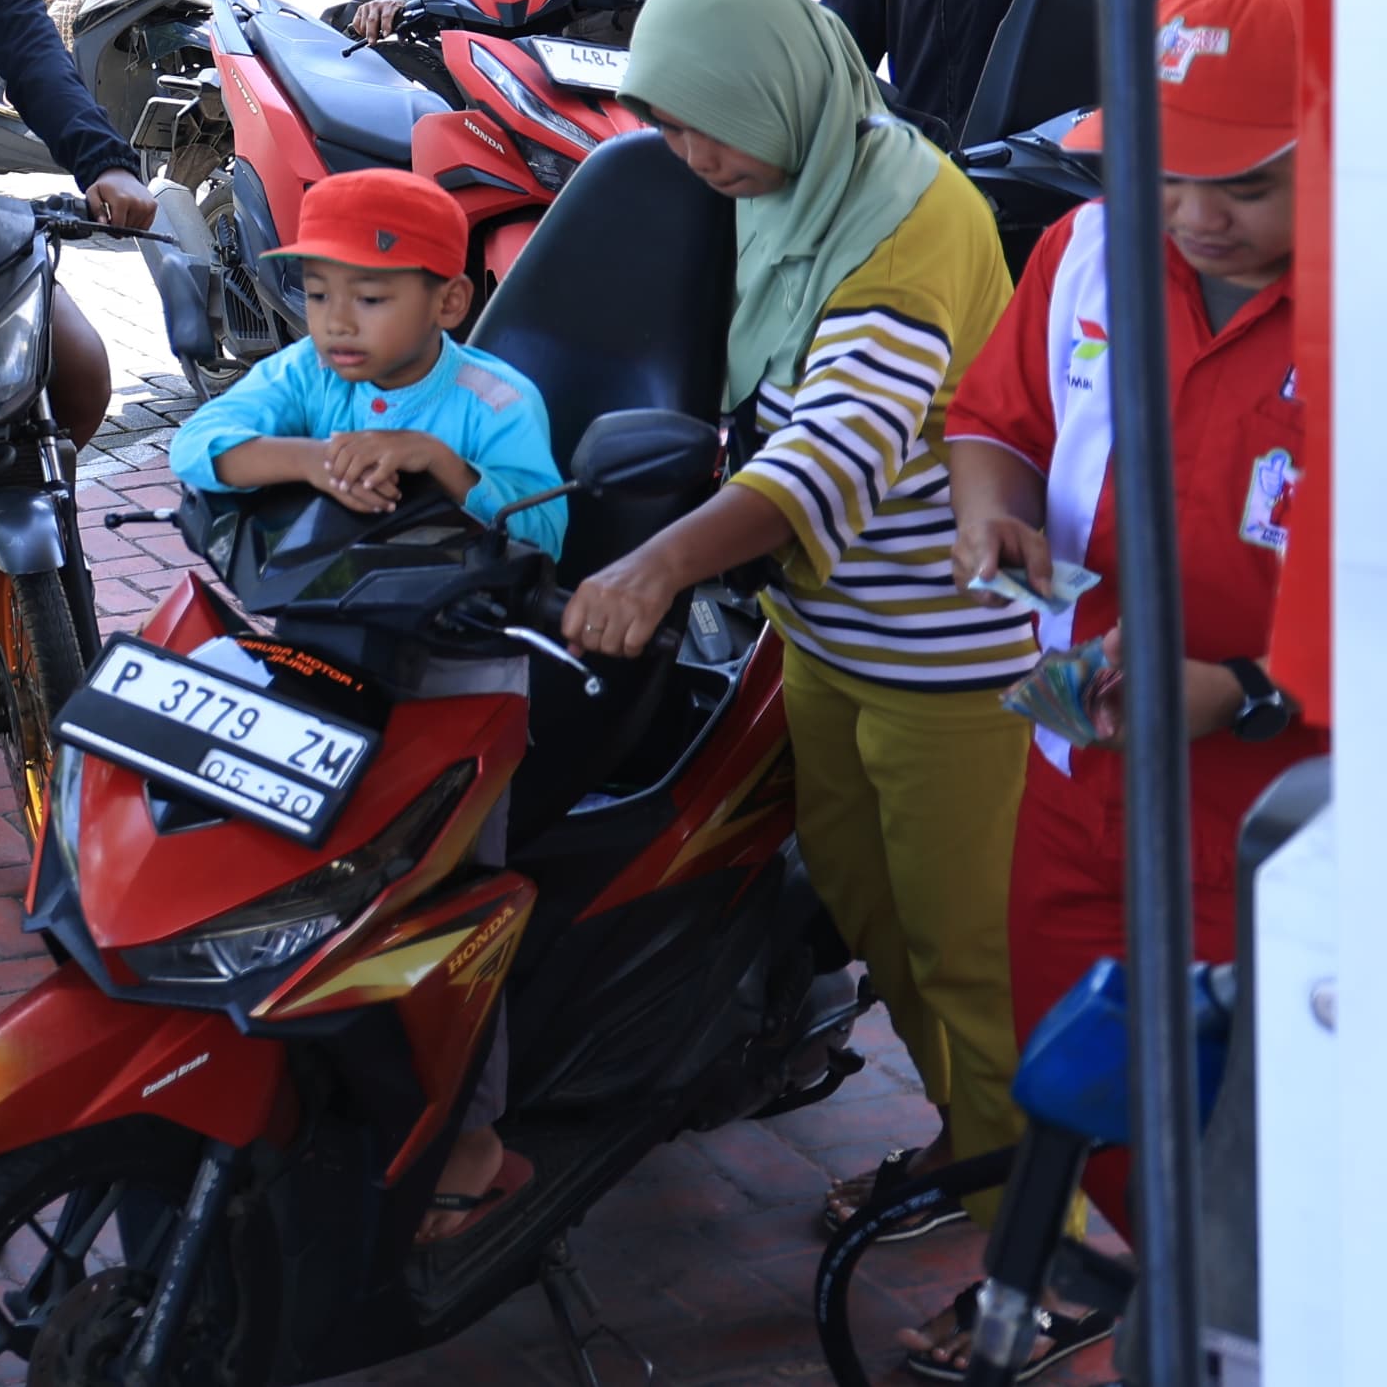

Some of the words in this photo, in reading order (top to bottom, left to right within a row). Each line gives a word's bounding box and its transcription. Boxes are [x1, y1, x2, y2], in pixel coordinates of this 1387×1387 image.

[543, 44, 554, 56] P
[570, 47, 618, 67] 4484
[463, 117, 506, 155] HONDA
[295, 651, 354, 687] MOTOR
[110, 661, 143, 694] P
[159, 679, 261, 741] 3779
[286, 729, 355, 787] ZM
[448, 906, 516, 975] HONDA
